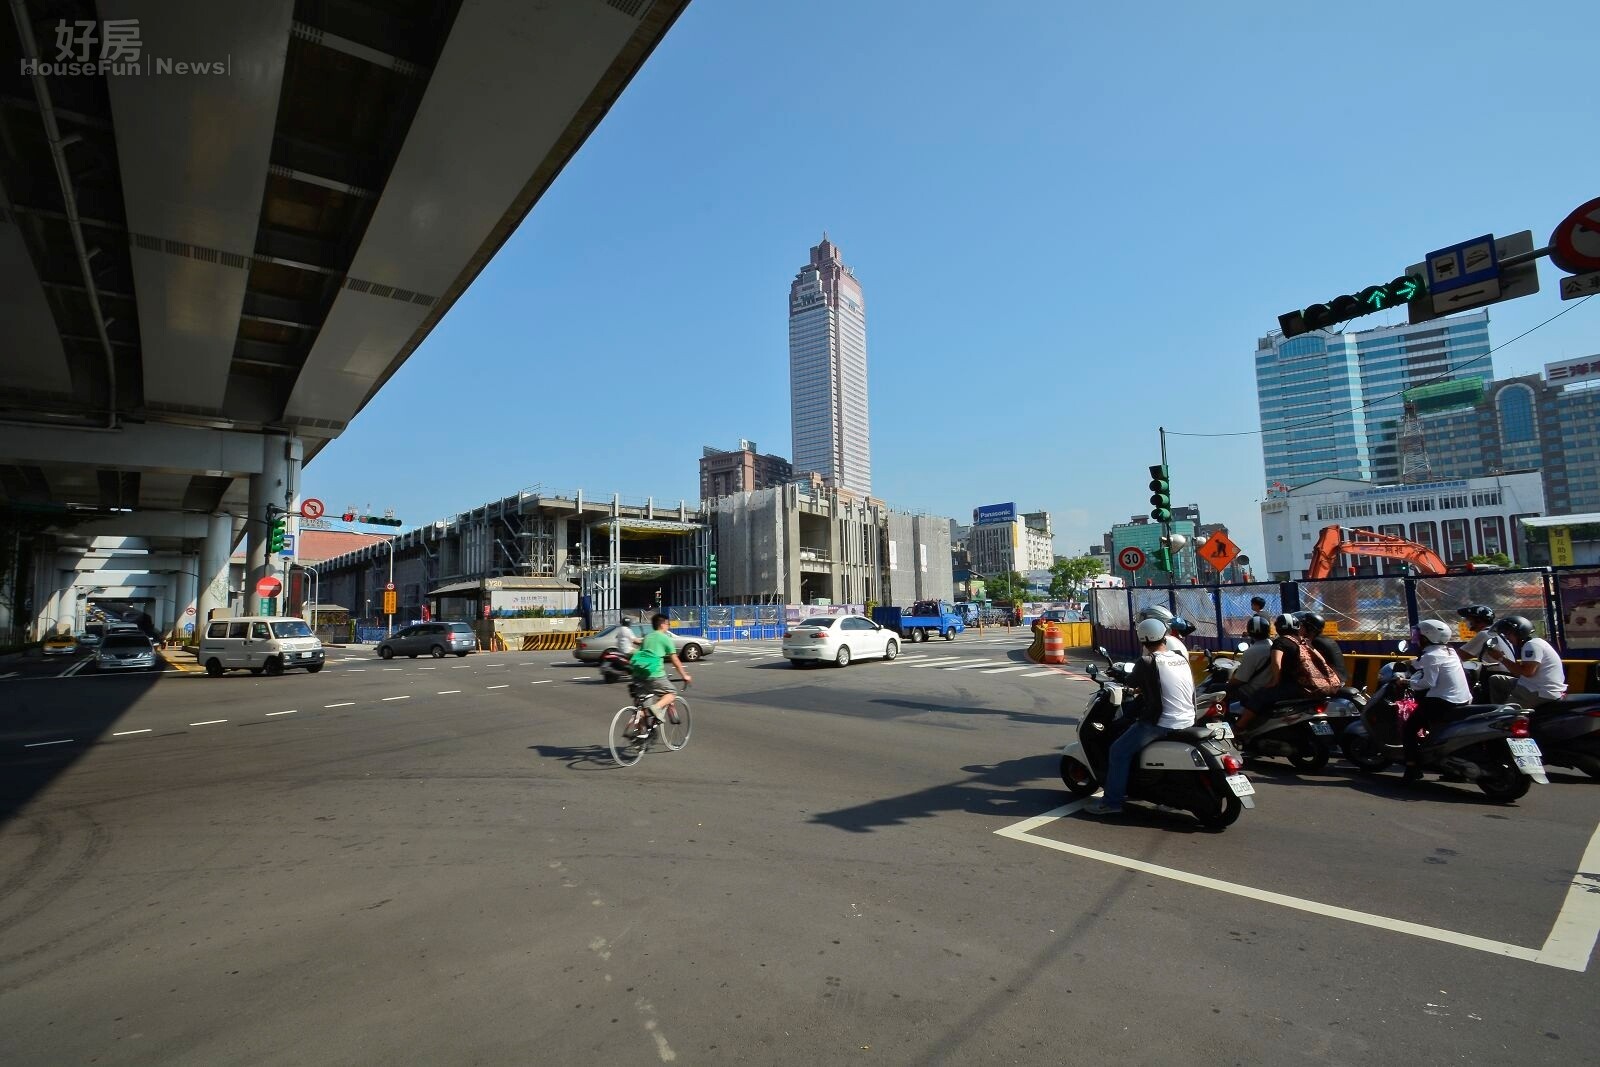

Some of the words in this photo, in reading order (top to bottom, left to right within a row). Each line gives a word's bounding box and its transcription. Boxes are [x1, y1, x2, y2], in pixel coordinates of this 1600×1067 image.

[980, 509, 1011, 518] Panasonic
[1124, 553, 1139, 565] 30
[488, 579, 503, 587] Y20
